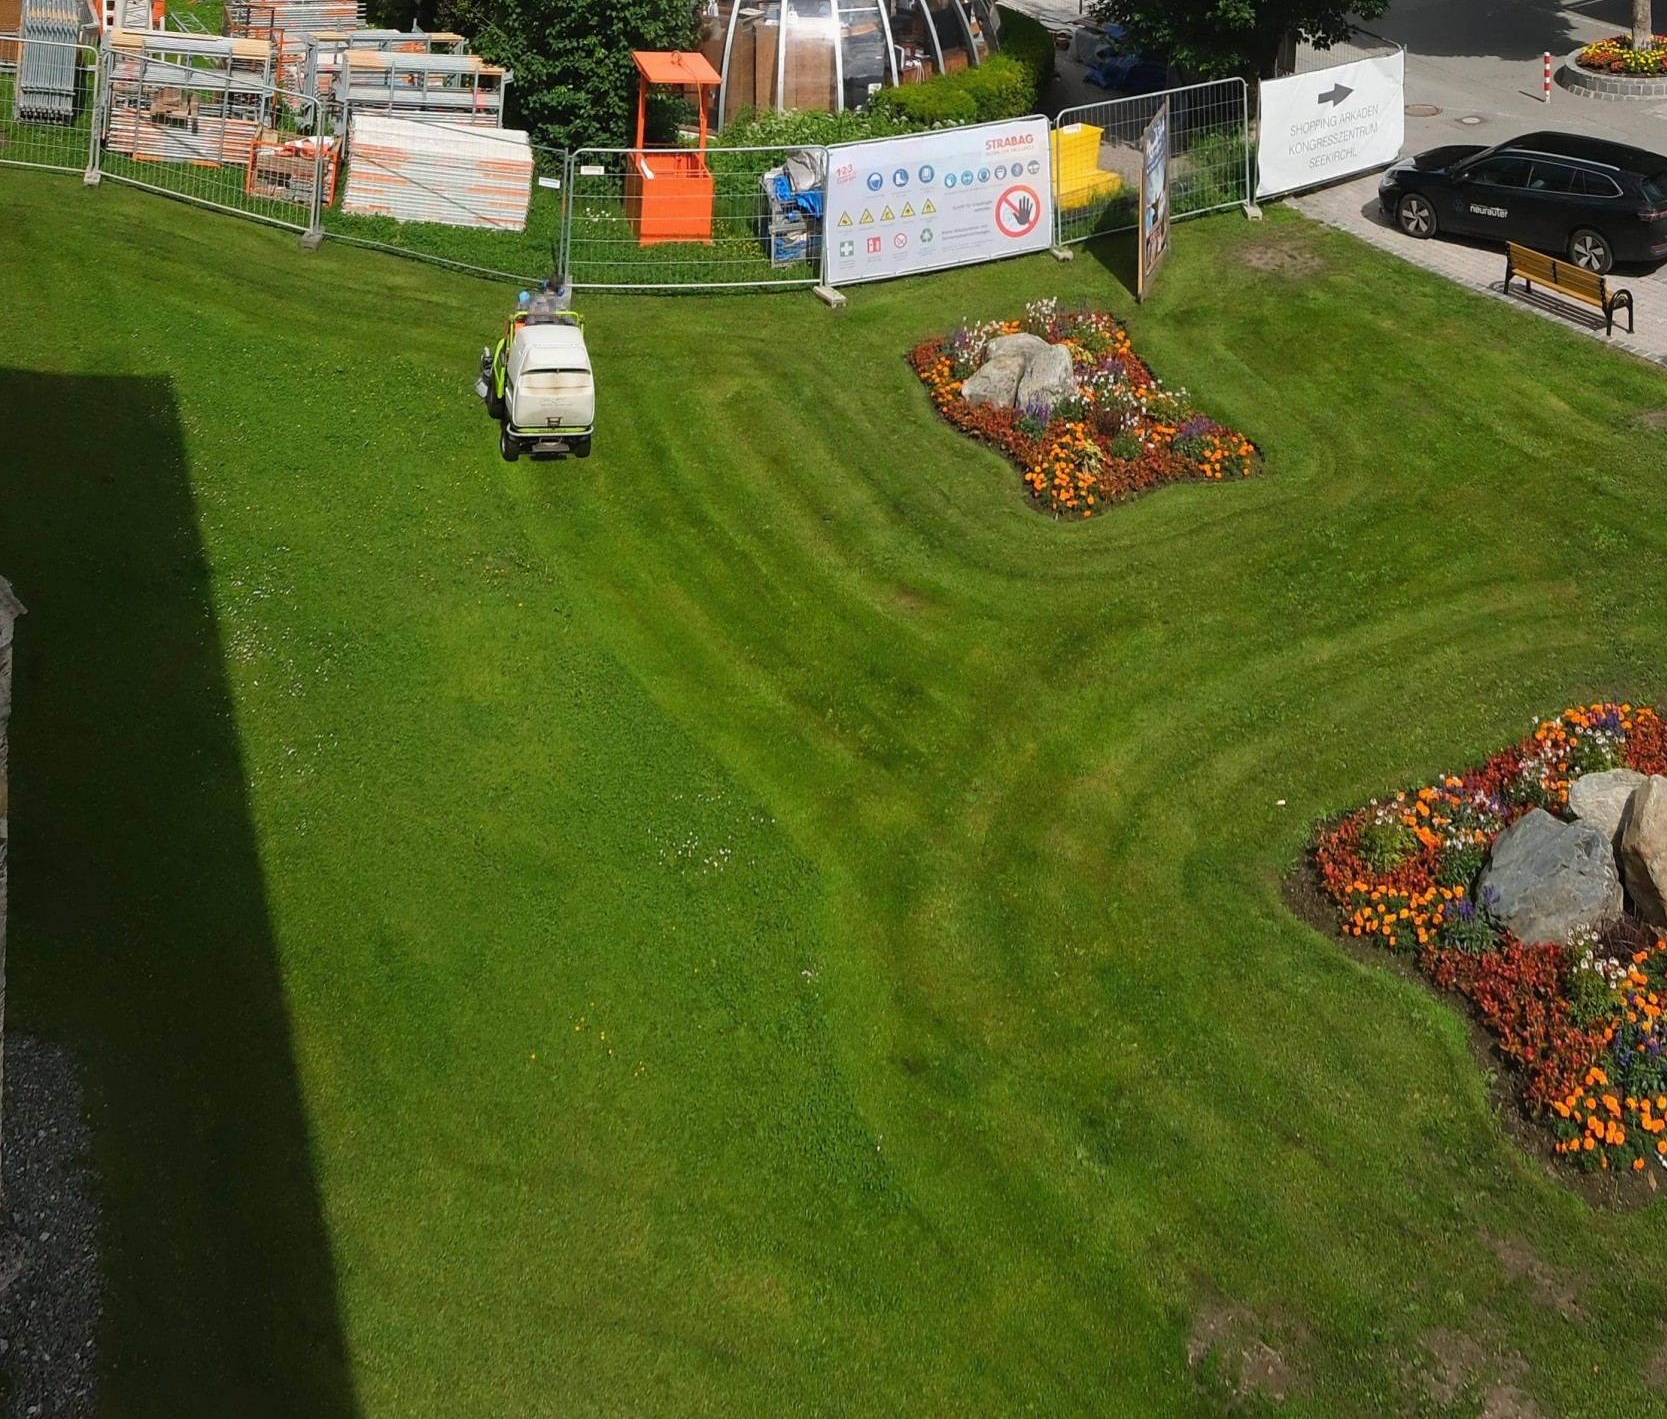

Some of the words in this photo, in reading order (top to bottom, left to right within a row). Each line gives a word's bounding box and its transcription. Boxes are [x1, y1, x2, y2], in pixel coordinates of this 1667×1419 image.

[1290, 115, 1337, 137] SHOPPING
[1339, 104, 1379, 124] ARKADEN
[985, 134, 1034, 150] STRABAG
[1288, 122, 1379, 156] KONGRESSZENTRUM
[1308, 147, 1358, 169] SEEKIRCHL
[1470, 205, 1508, 218] neurauter
